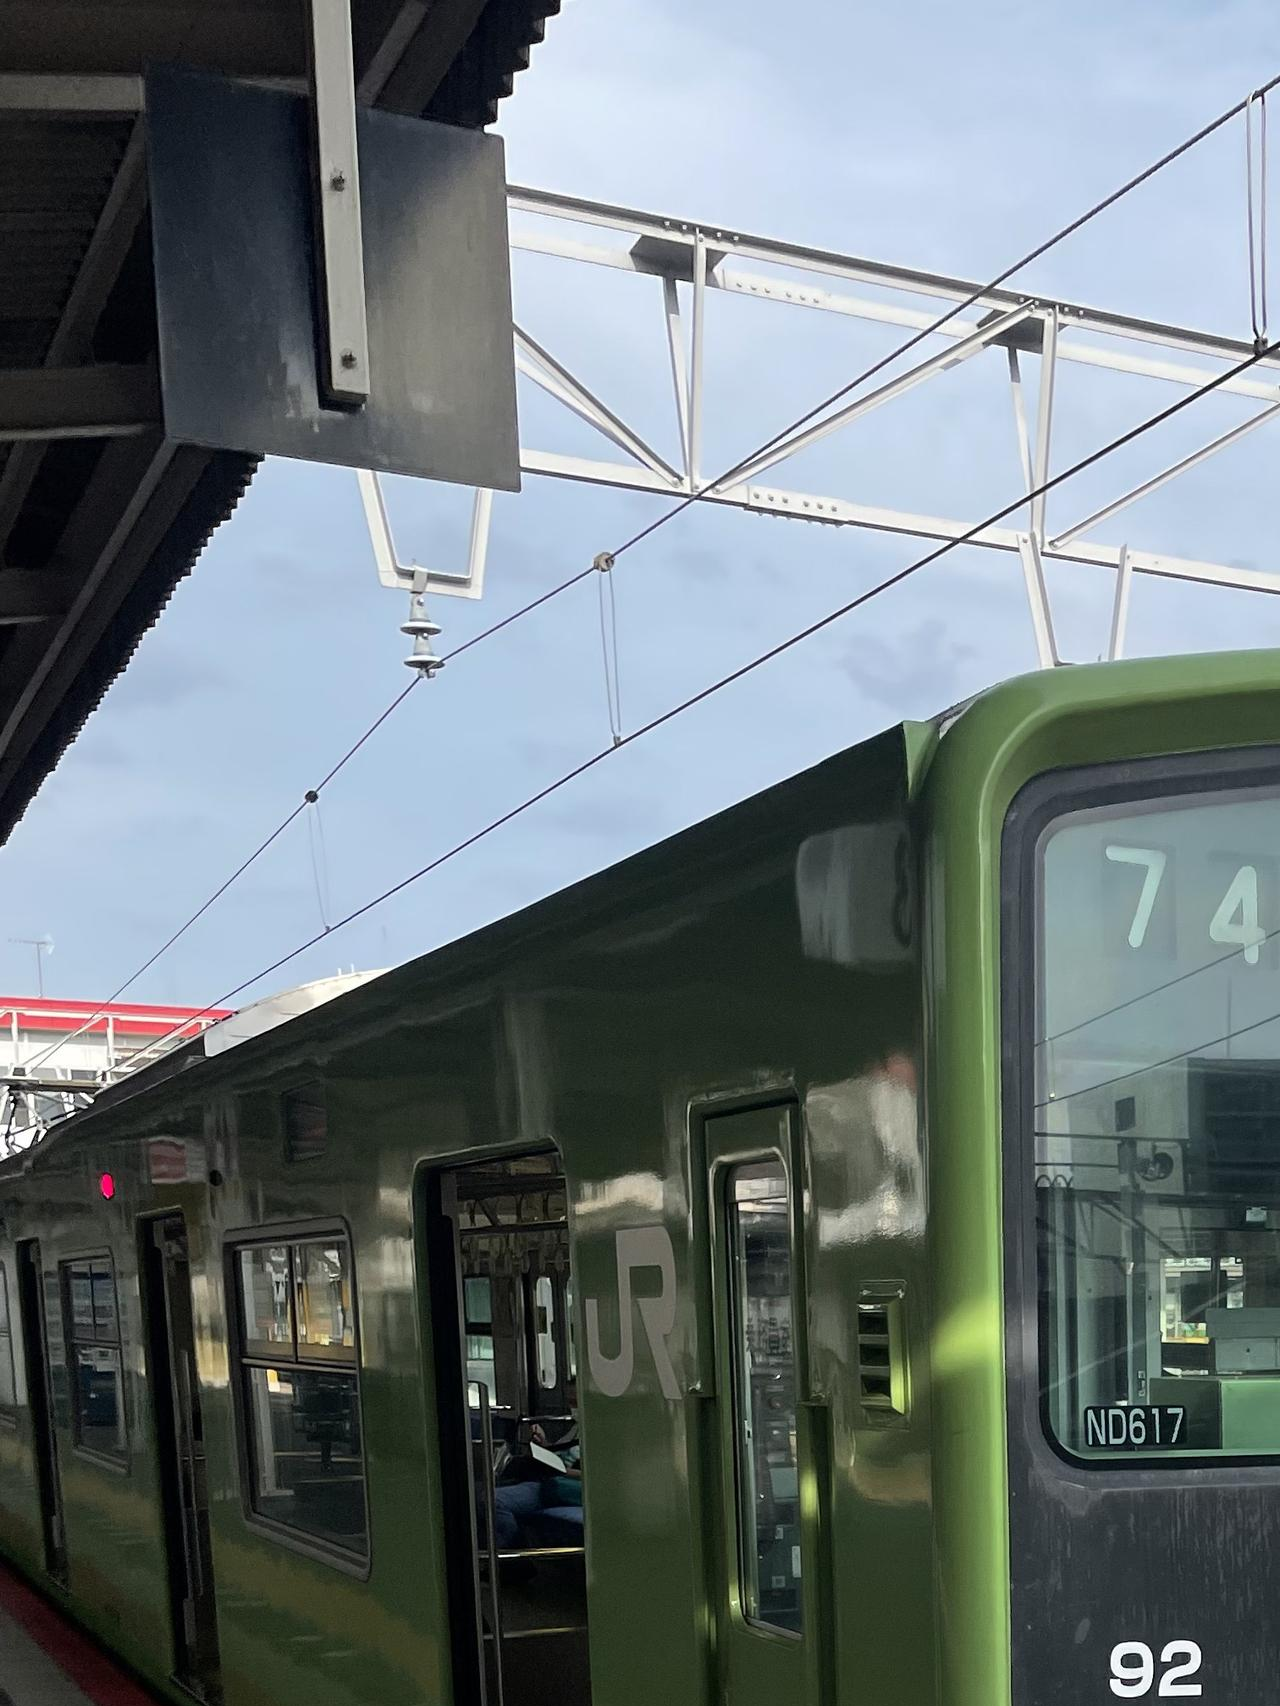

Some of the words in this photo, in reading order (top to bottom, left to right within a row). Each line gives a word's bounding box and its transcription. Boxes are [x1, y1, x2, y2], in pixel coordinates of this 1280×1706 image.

[585, 1226, 682, 1399] JR
[1087, 1407, 1184, 1446] ND617
[1109, 1640, 1202, 1698] 92
